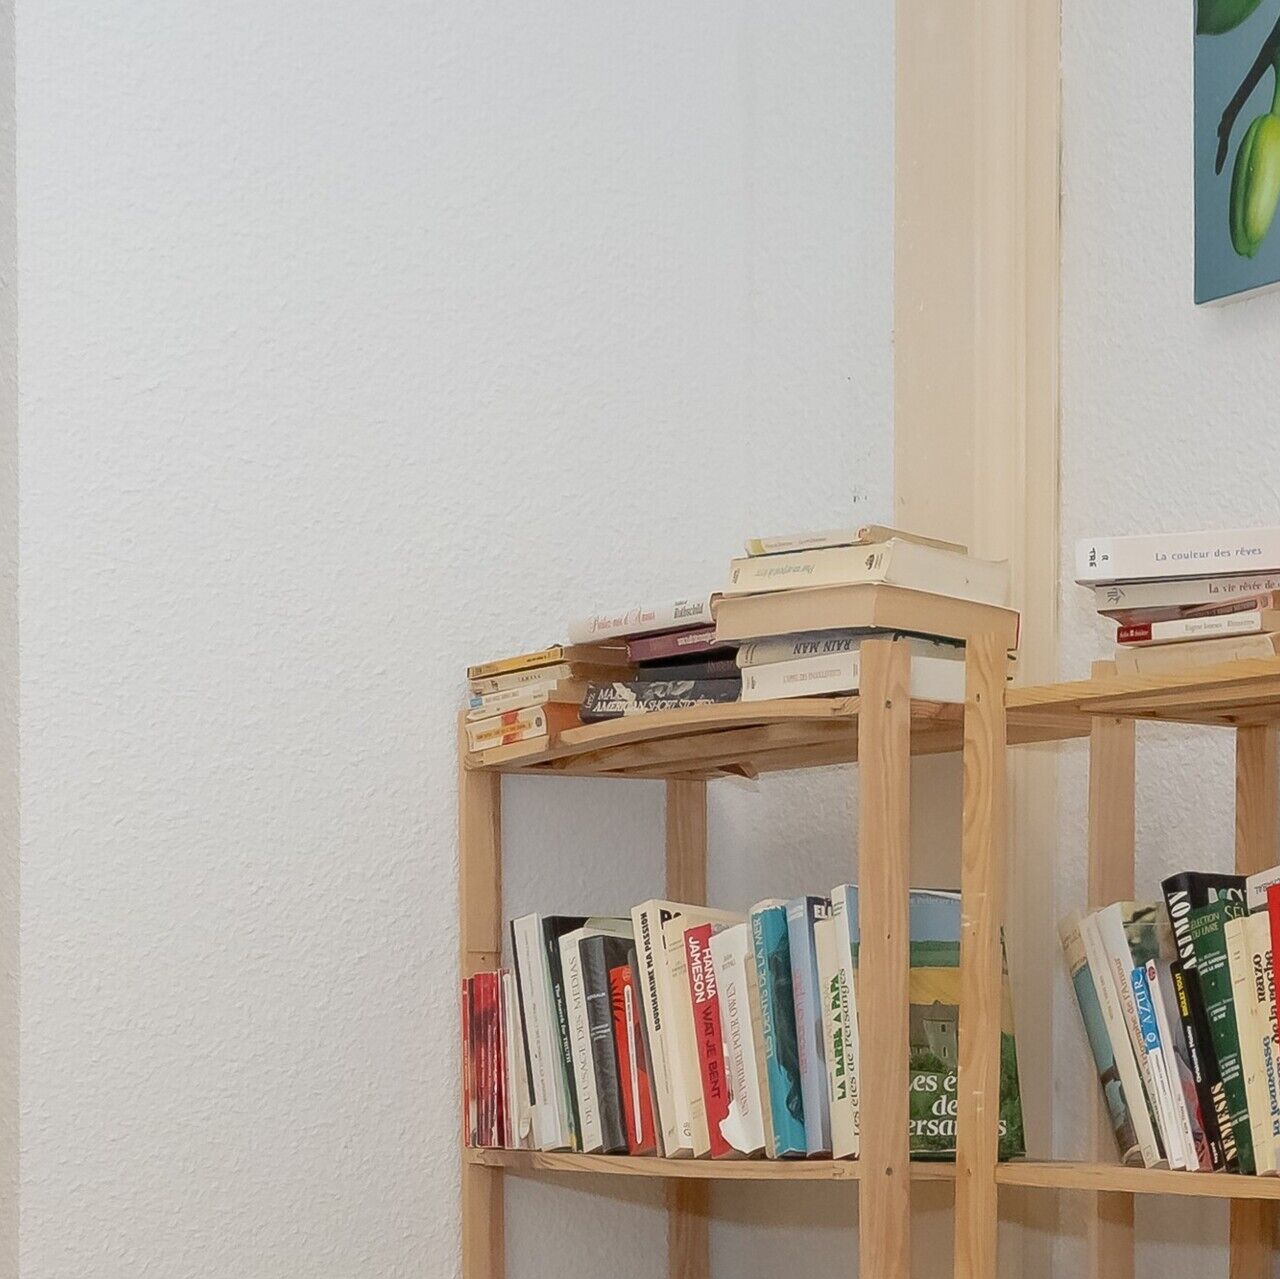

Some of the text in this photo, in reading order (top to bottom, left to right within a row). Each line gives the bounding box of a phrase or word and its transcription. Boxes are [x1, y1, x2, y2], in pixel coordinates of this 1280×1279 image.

[1155, 547, 1262, 562] La couleur des rêves
[1209, 584, 1219, 594] La
[1223, 583, 1236, 592] vie
[1265, 579, 1275, 589] de
[793, 639, 852, 655] RAIN MAN
[640, 912, 654, 968] MA PASSION
[1167, 890, 1197, 968] ASIMOV
[688, 937, 705, 1003] JAMESON
[703, 949, 717, 999] HANNA
[752, 917, 774, 1058] LES DENTS DE LA MER
[827, 975, 839, 1008] PAPA
[1114, 957, 1130, 1000] l'Amour
[1251, 954, 1266, 1002] mazo
[727, 982, 737, 1016] OWEN
[1125, 1002, 1134, 1013] de
[1133, 976, 1153, 1024] AZUR
[703, 1006, 721, 1098] WAT JE BENT
[731, 1019, 742, 1049] POUR
[575, 1014, 593, 1126] DE DES
[844, 1053, 854, 1069] de
[1261, 1036, 1279, 1118] jeunesse
[836, 1080, 846, 1100] LA
